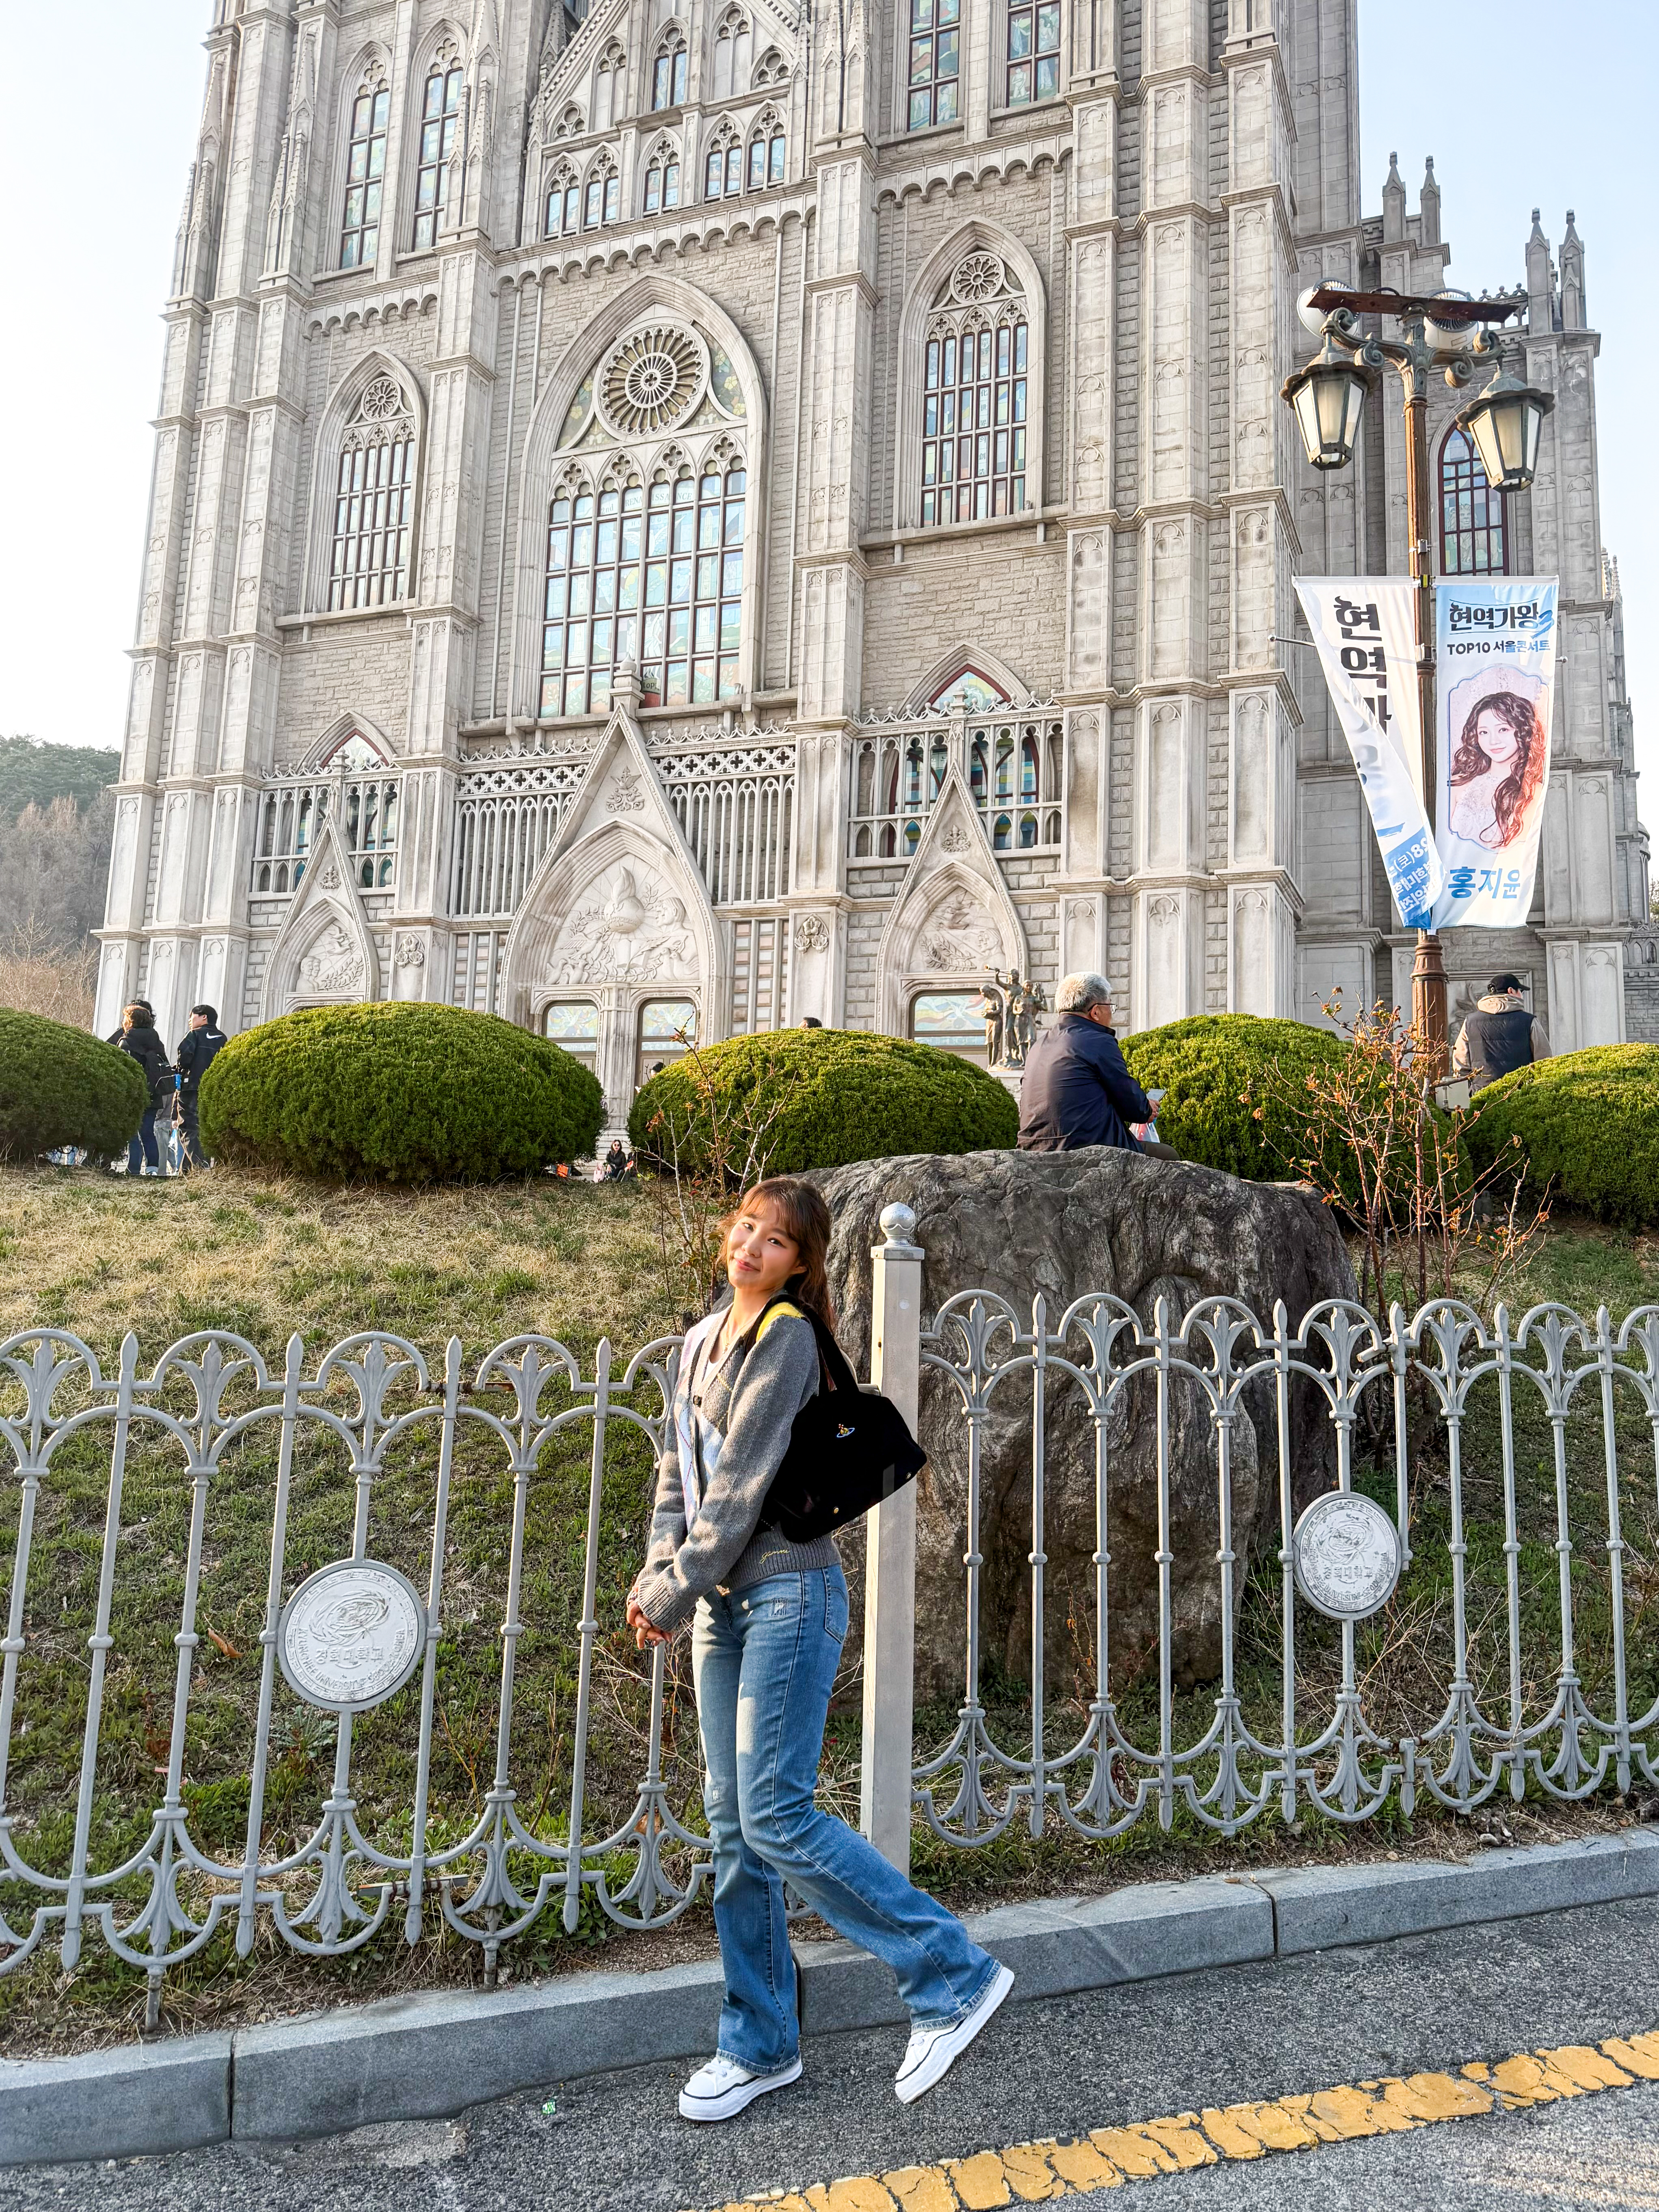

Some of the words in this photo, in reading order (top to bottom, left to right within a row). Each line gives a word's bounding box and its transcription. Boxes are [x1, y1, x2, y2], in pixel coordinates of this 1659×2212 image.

[601, 504, 613, 514] 2nd
[1447, 642, 1491, 655] TOP10
[1493, 640, 1551, 653] 서울콘서트
[1448, 866, 1521, 899] 홍지윤
[315, 1646, 383, 1664] 경희대학교
